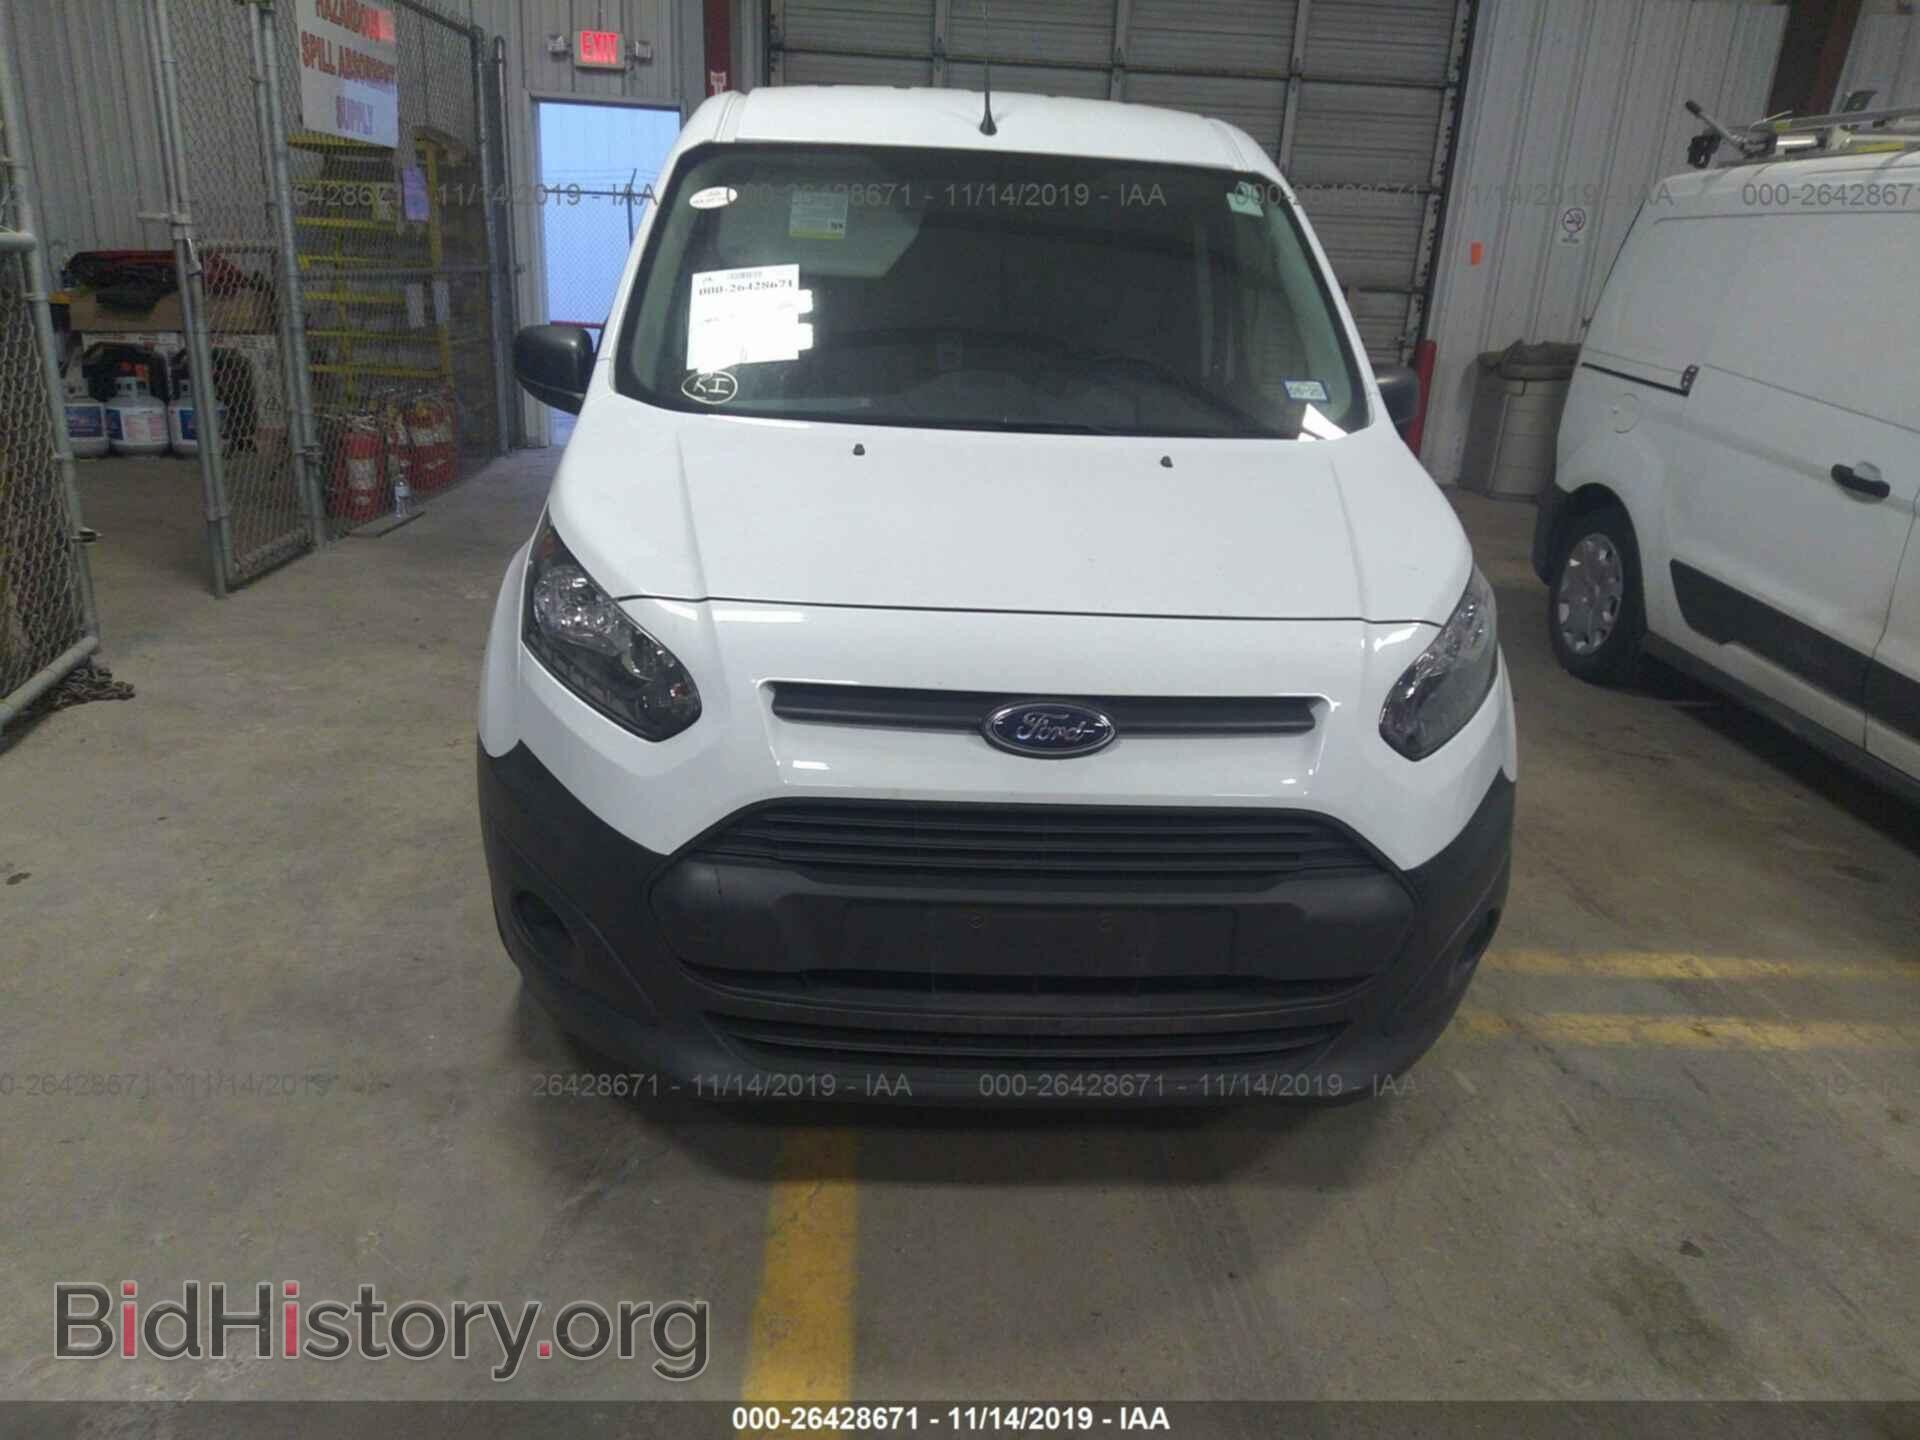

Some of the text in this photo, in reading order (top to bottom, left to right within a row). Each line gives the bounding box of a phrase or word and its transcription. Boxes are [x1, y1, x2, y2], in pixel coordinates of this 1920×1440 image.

[301, 31, 336, 75] SPILL
[581, 31, 618, 64] EXIT
[1016, 711, 1095, 742] Ford
